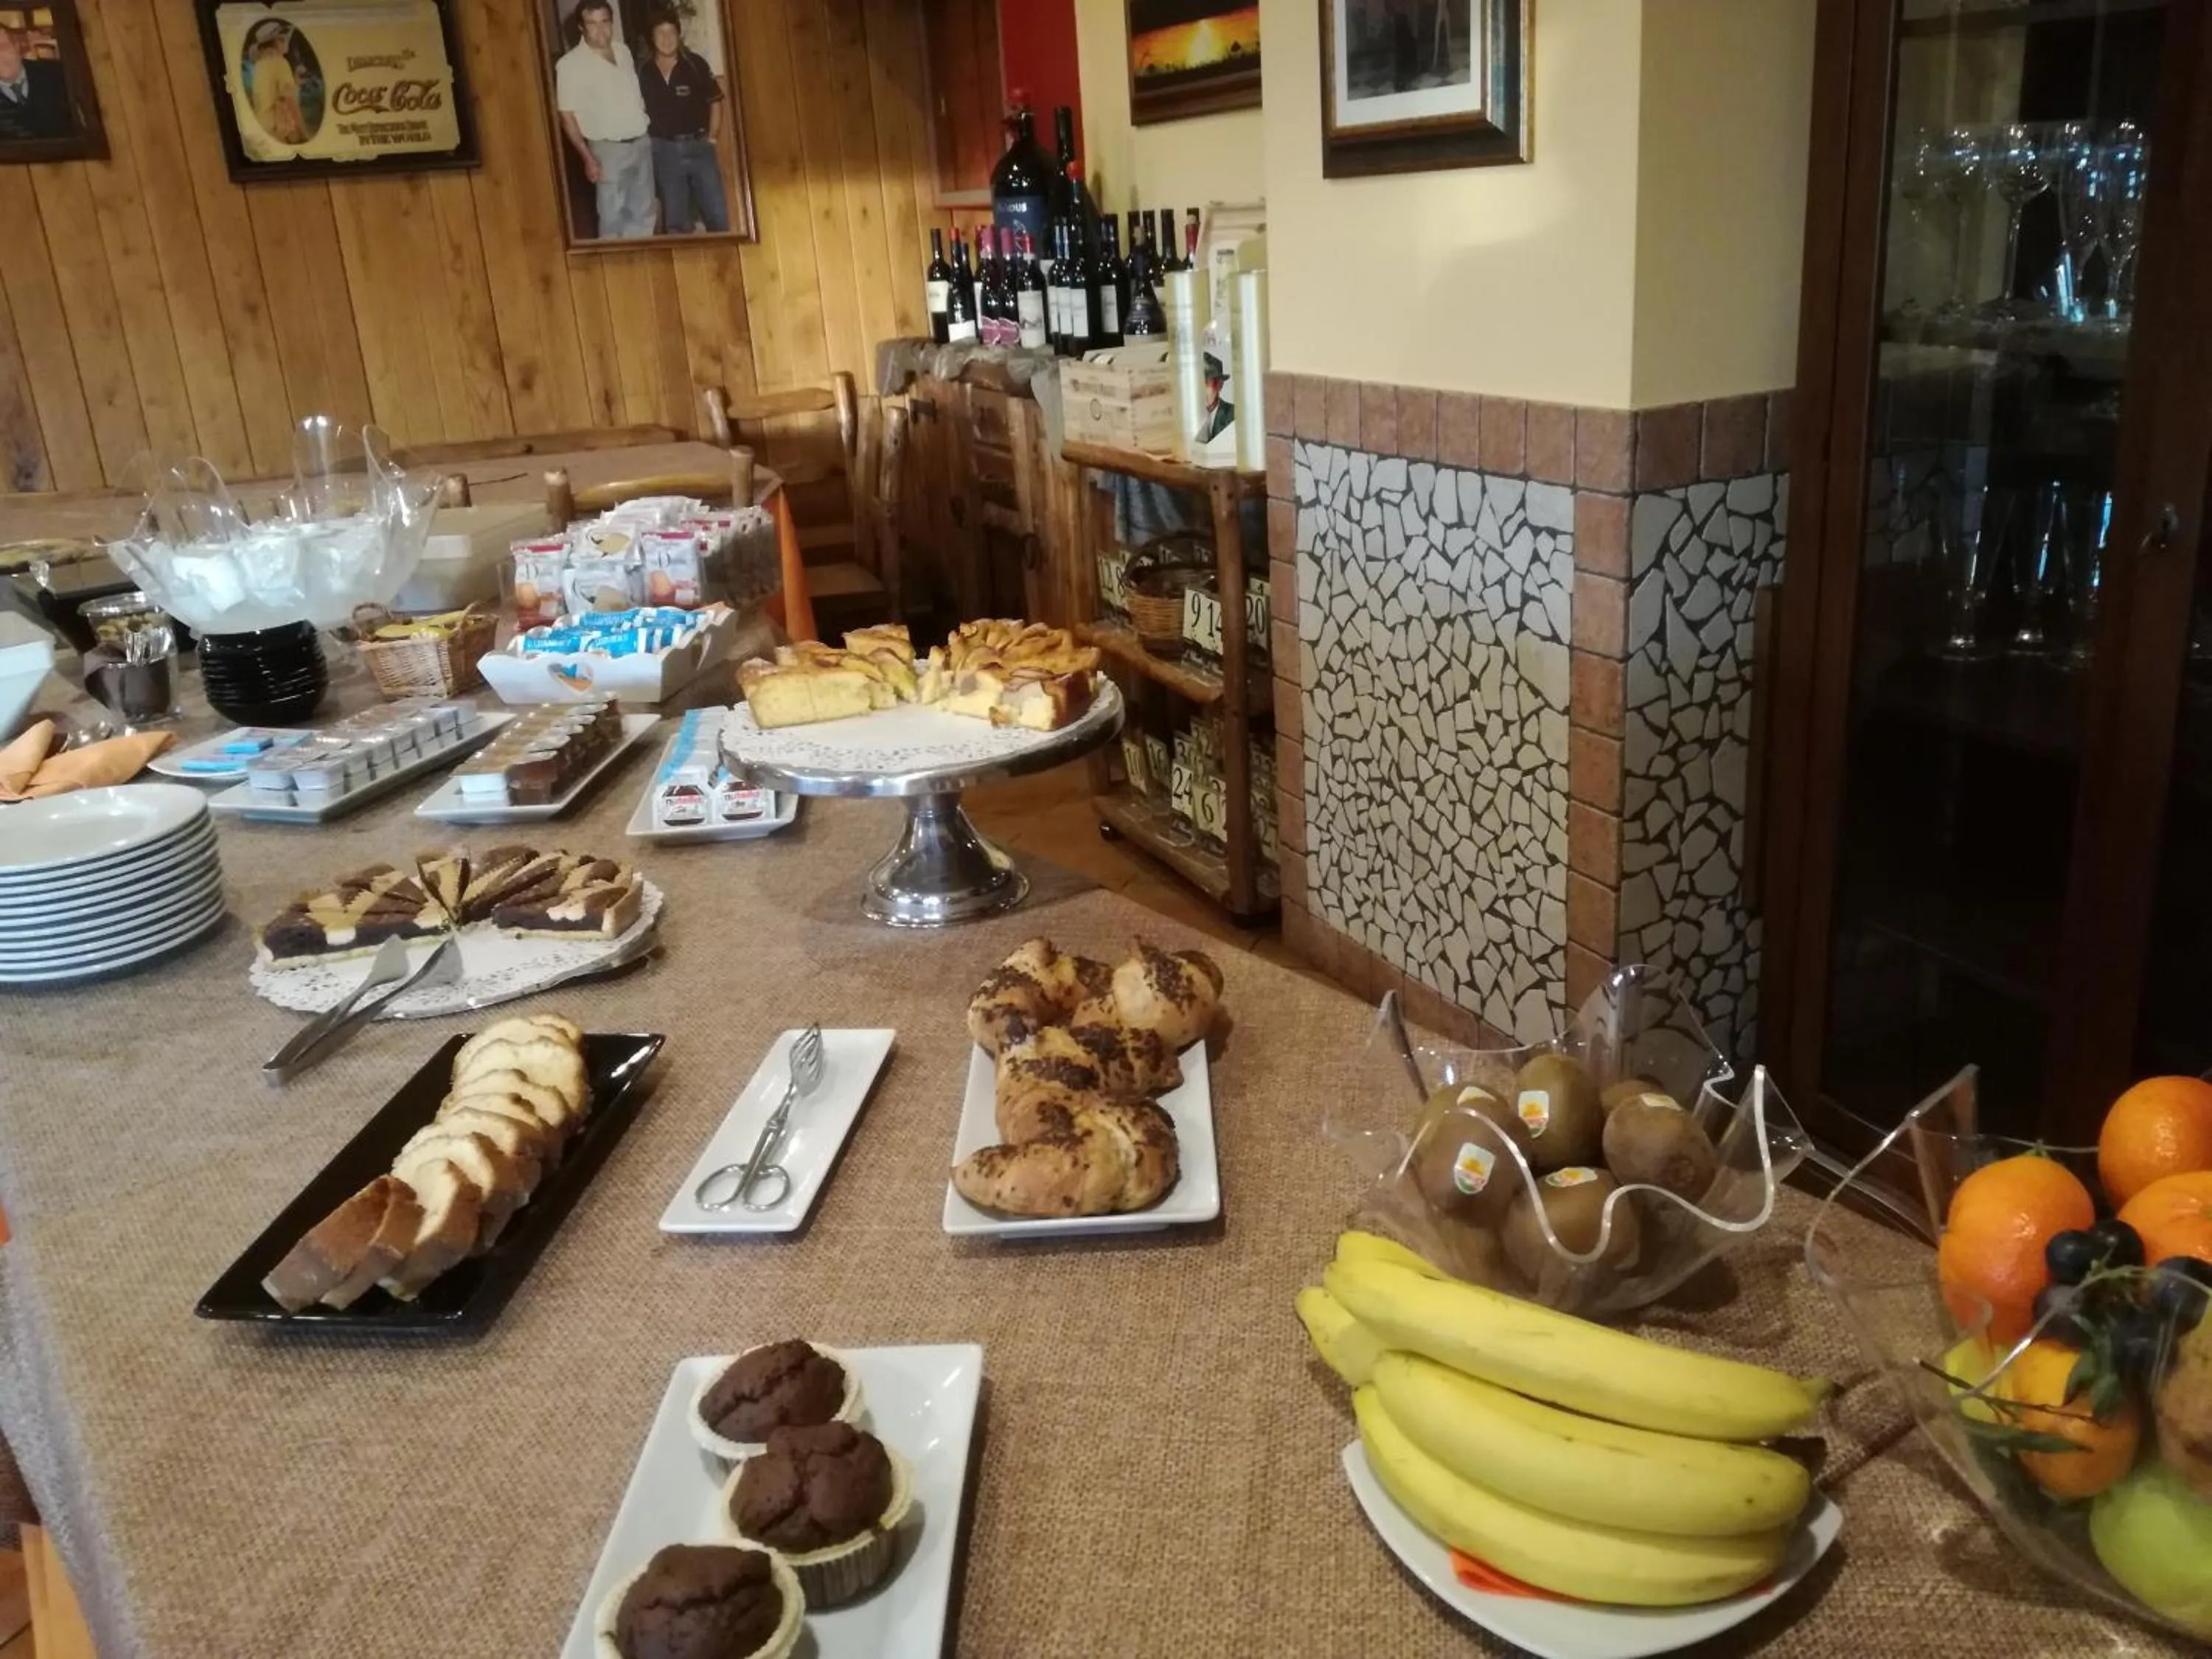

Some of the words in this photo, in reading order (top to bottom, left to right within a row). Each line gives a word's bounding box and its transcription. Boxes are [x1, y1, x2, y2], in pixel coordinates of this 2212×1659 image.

[1192, 592, 1202, 628] 9
[1173, 766, 1193, 804] 24
[1202, 792, 1214, 824] 6
